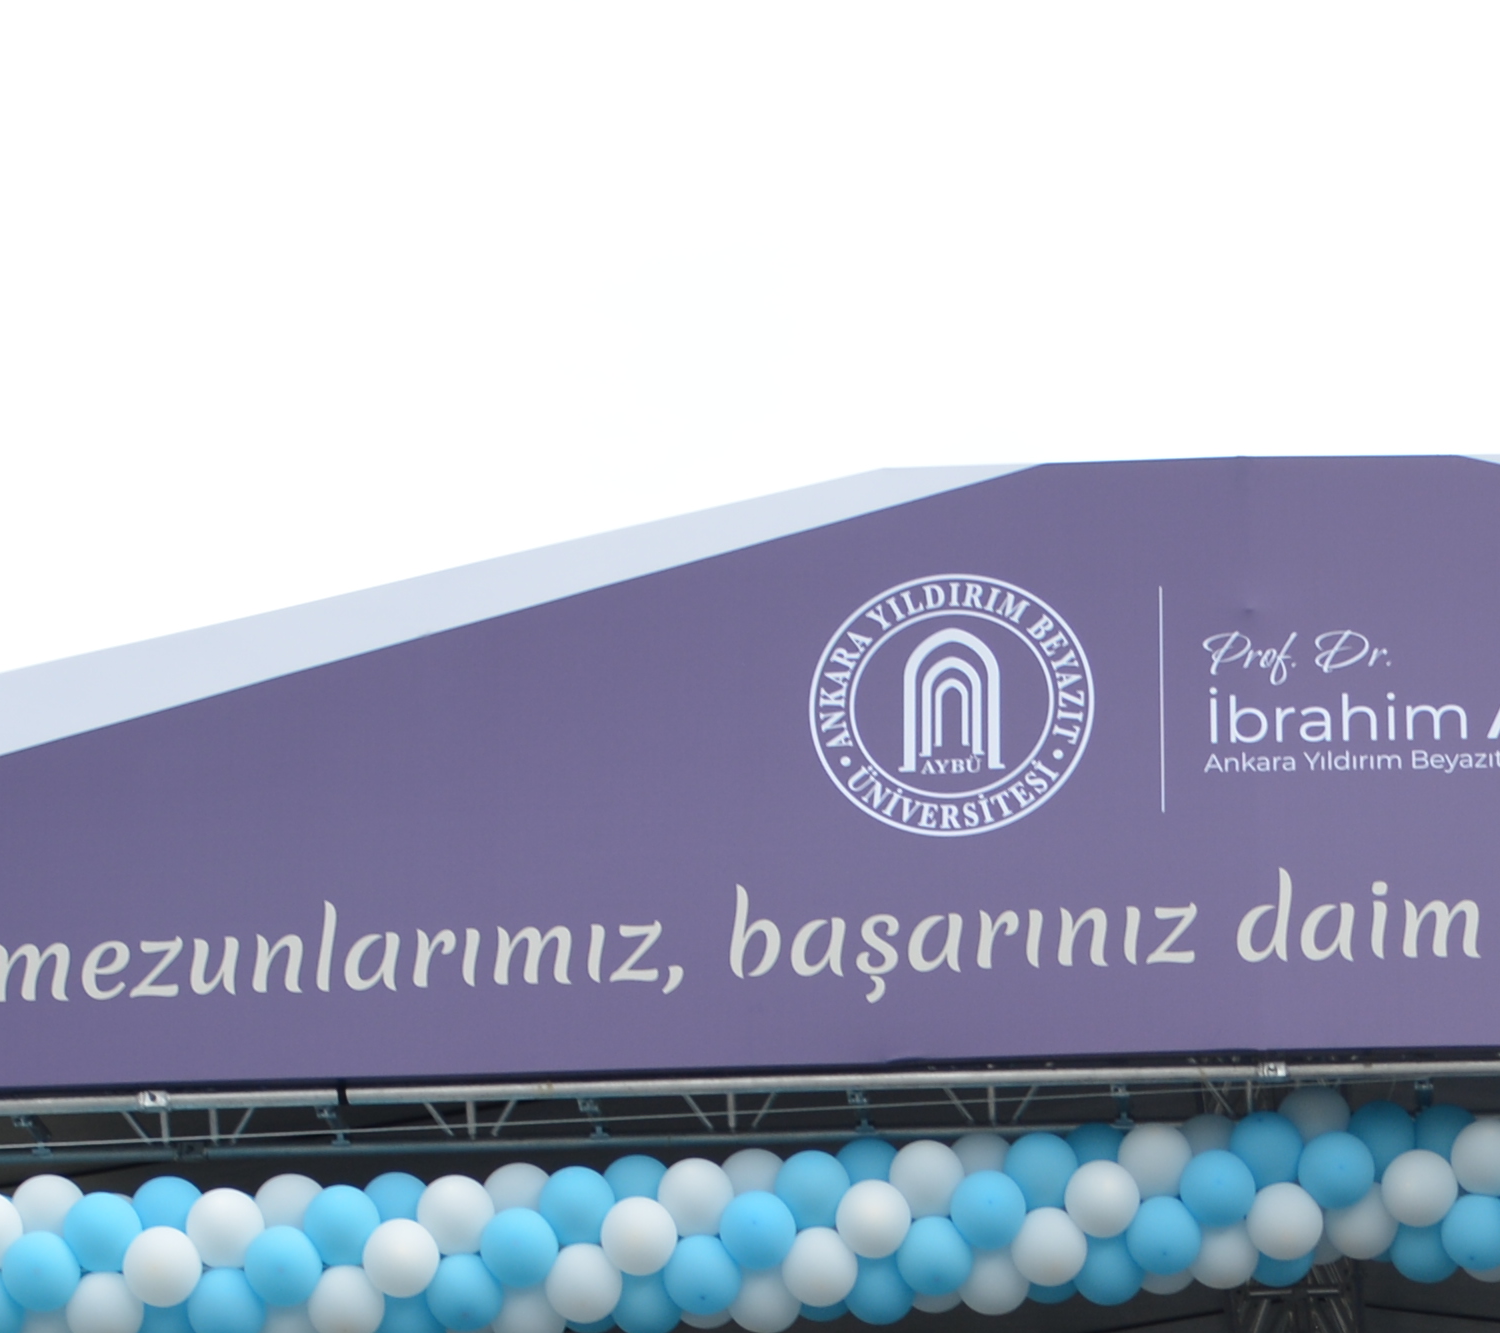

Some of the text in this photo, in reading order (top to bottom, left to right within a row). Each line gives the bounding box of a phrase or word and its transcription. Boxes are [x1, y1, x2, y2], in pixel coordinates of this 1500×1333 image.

[819, 582, 1085, 747] ANKARA YILDIRIM BEYAZIT
[1203, 629, 1392, 685] Prof. Dr.
[1209, 687, 1468, 743] İbrahim
[920, 753, 982, 775] AYBÜ
[1203, 751, 1297, 773] Ankara
[1303, 749, 1403, 771] Yıldırım
[847, 758, 1059, 829] ÜNİVERSİTESİ
[729, 883, 1198, 1004] başarınız
[1236, 866, 1481, 963] daim
